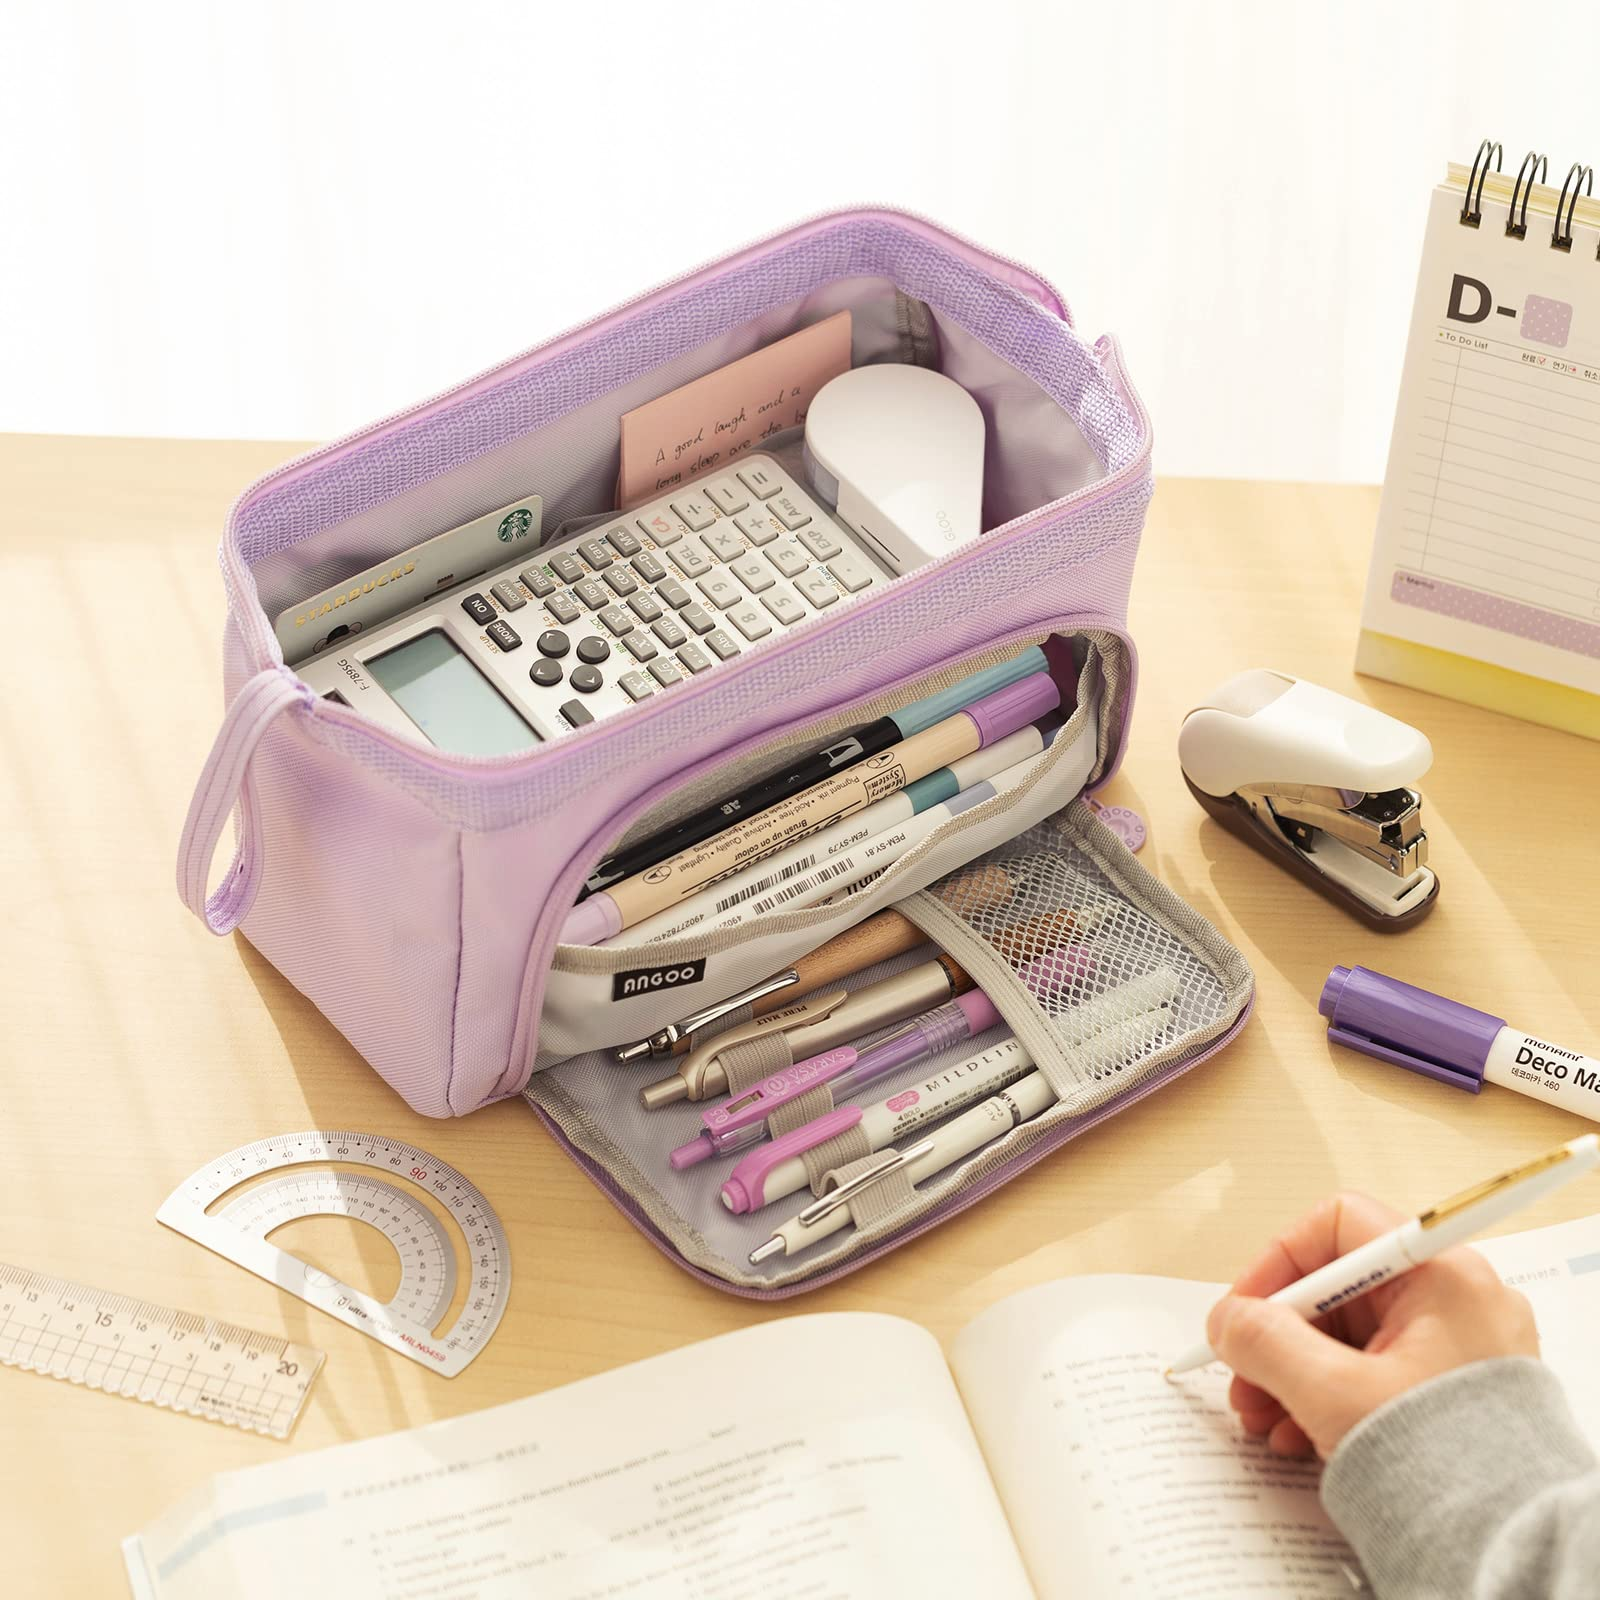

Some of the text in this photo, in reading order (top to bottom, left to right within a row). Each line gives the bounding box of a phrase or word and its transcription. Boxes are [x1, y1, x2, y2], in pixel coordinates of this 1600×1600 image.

[1445, 332, 1488, 350] To Do List
[1521, 352, 1537, 363] 완료
[1552, 361, 1568, 372] 연기
[655, 387, 800, 466] A good laugh and a
[729, 440, 752, 456] are
[759, 422, 783, 440] the
[778, 497, 801, 516] Ans
[651, 516, 671, 533] CA
[597, 537, 608, 545] M
[617, 531, 634, 546] M+
[639, 538, 656, 550] OFF
[807, 530, 832, 549] EXP
[587, 543, 604, 559] tan
[679, 544, 702, 566] DEL
[778, 549, 795, 560] 3
[561, 558, 574, 570] ln
[667, 561, 687, 582] Insert
[743, 565, 760, 575] 6
[528, 569, 548, 586] ENG
[610, 569, 629, 584] cos
[498, 583, 520, 601] CONVT
[583, 582, 599, 598] log
[711, 581, 728, 592] 9
[808, 579, 825, 591] 2
[293, 559, 416, 628] STARBUCKS
[471, 599, 487, 613] ON
[637, 595, 654, 609] sin
[702, 600, 716, 612] CLR
[773, 597, 791, 607] 5
[589, 617, 605, 630] OCT
[740, 612, 757, 623] 8
[492, 619, 515, 643] MODE
[660, 619, 678, 637] hyp
[613, 642, 626, 653] BIN
[715, 633, 733, 648] Abs
[639, 669, 654, 682] HEX
[870, 775, 906, 797] Memory
[678, 775, 860, 872] Pigment ink Acid-free Archival Quality Lightfast
[734, 818, 807, 861] Brush up on colour
[827, 829, 868, 854] PEM-SY.79
[864, 832, 905, 857] PEM-SY.81
[623, 966, 694, 992] ANGOO
[756, 1004, 807, 1025] PURE MALT
[1523, 1037, 1584, 1062] monami
[788, 1049, 846, 1082] SARASA
[1515, 1046, 1568, 1079] Deco
[1511, 1067, 1560, 1092] 데코마카 460
[902, 1106, 920, 1120] BOLD
[892, 1117, 917, 1132] ZEBRA
[281, 1151, 294, 1159] 40
[309, 1147, 321, 1155] 50
[337, 1147, 349, 1155] 60
[364, 1150, 377, 1160] 70
[256, 1157, 268, 1167] 30
[389, 1157, 401, 1167] 80
[230, 1168, 243, 1178] 20
[409, 1166, 428, 1181] 90
[432, 1179, 448, 1193] 100
[362, 1201, 375, 1209] 100
[450, 1195, 464, 1209] 110
[391, 1214, 401, 1223] 80
[465, 1213, 477, 1227] 120
[402, 1225, 412, 1234] 70
[474, 1232, 486, 1247] 130
[479, 1254, 489, 1268] 140
[479, 1275, 488, 1290] 150
[26, 1292, 38, 1303] 13
[472, 1296, 484, 1311] 160
[63, 1302, 75, 1313] 14
[348, 1304, 367, 1319] ultra
[93, 1311, 114, 1328] 15
[135, 1321, 148, 1332] 16
[172, 1330, 186, 1342] 17
[209, 1341, 222, 1352] 18
[246, 1350, 259, 1361] 19
[276, 1360, 298, 1377] 20
